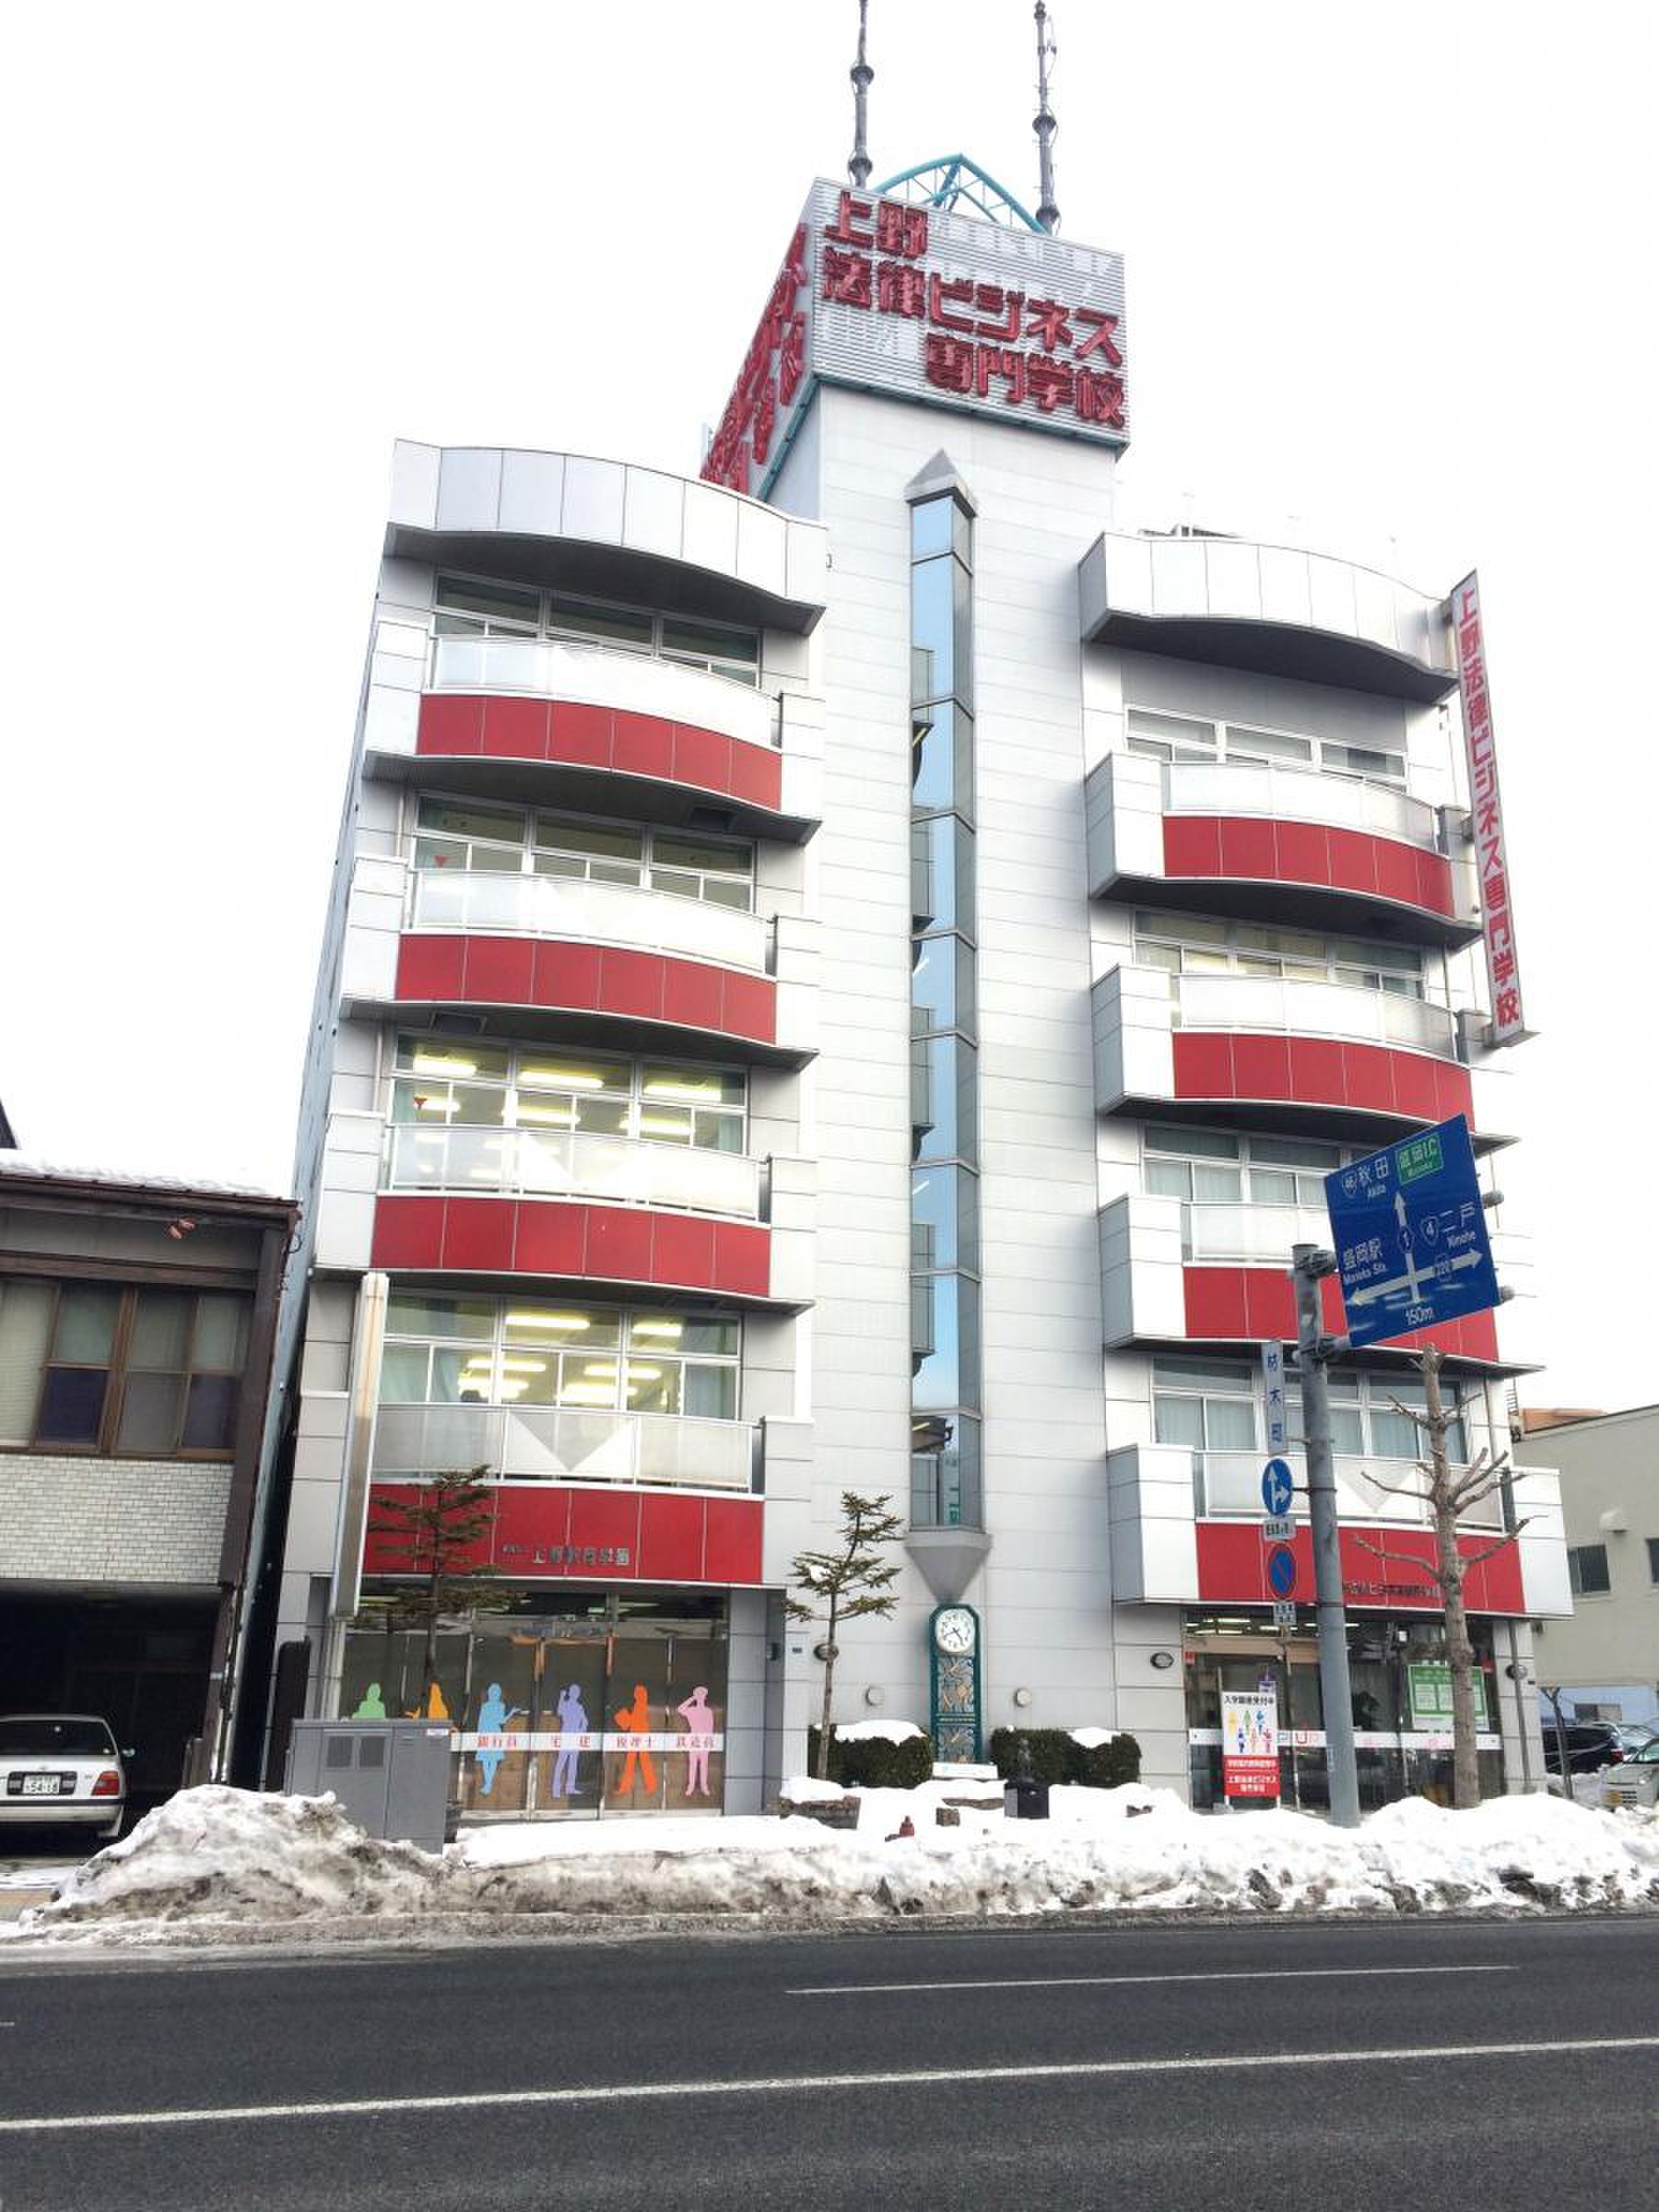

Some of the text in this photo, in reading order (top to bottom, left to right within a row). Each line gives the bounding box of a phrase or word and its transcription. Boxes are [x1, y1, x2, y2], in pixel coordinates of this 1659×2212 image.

[824, 190, 928, 260] 上野
[823, 245, 1124, 366] 法律ビジネス
[925, 333, 1125, 429] 専門学校
[1460, 588, 1521, 1028] 上野法律ビジネス専門学校
[1357, 1156, 1388, 1183] 秋田
[1440, 1202, 1475, 1232] 二戸
